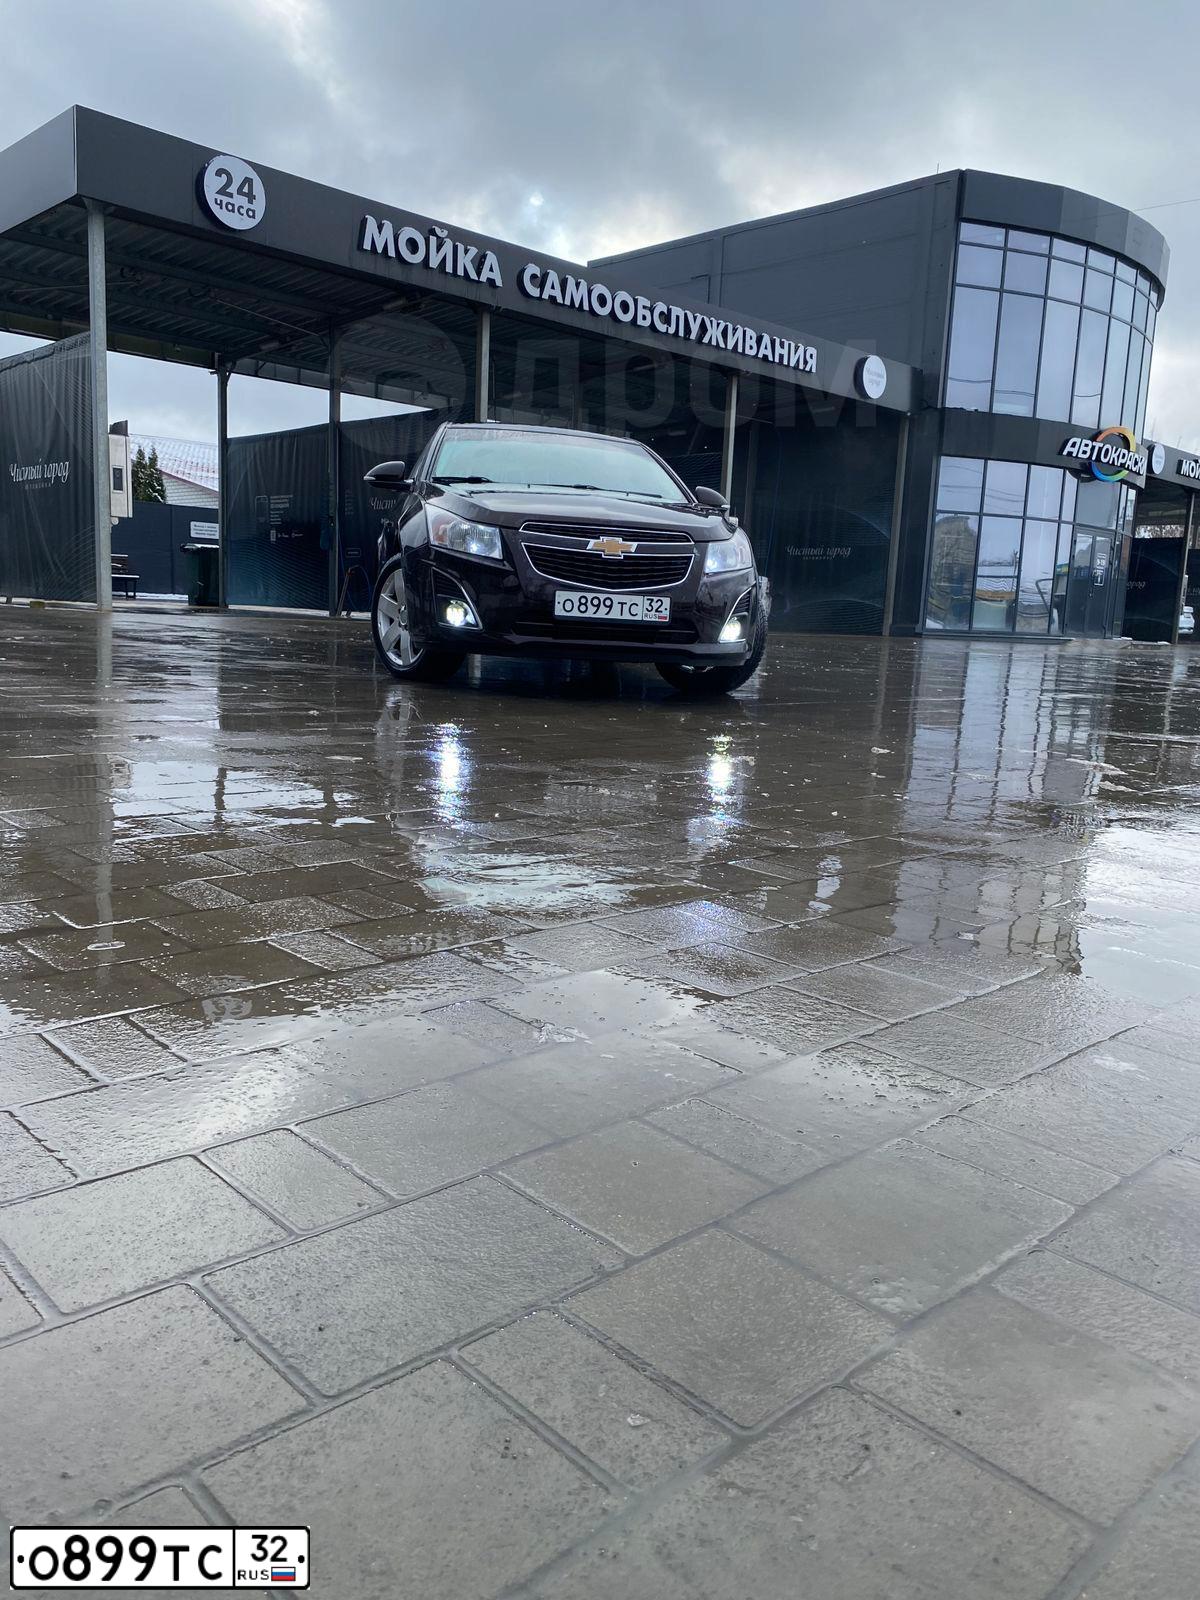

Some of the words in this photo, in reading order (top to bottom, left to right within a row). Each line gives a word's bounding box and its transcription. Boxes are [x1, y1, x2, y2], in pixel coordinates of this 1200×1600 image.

[215, 167, 257, 205] 24
[214, 197, 257, 220] часа
[362, 215, 503, 287] МОЙКА
[521, 263, 817, 373] САМООБСЛУЖИВАНИЯ
[644, 612, 658, 620] RUS
[645, 598, 664, 613] 32
